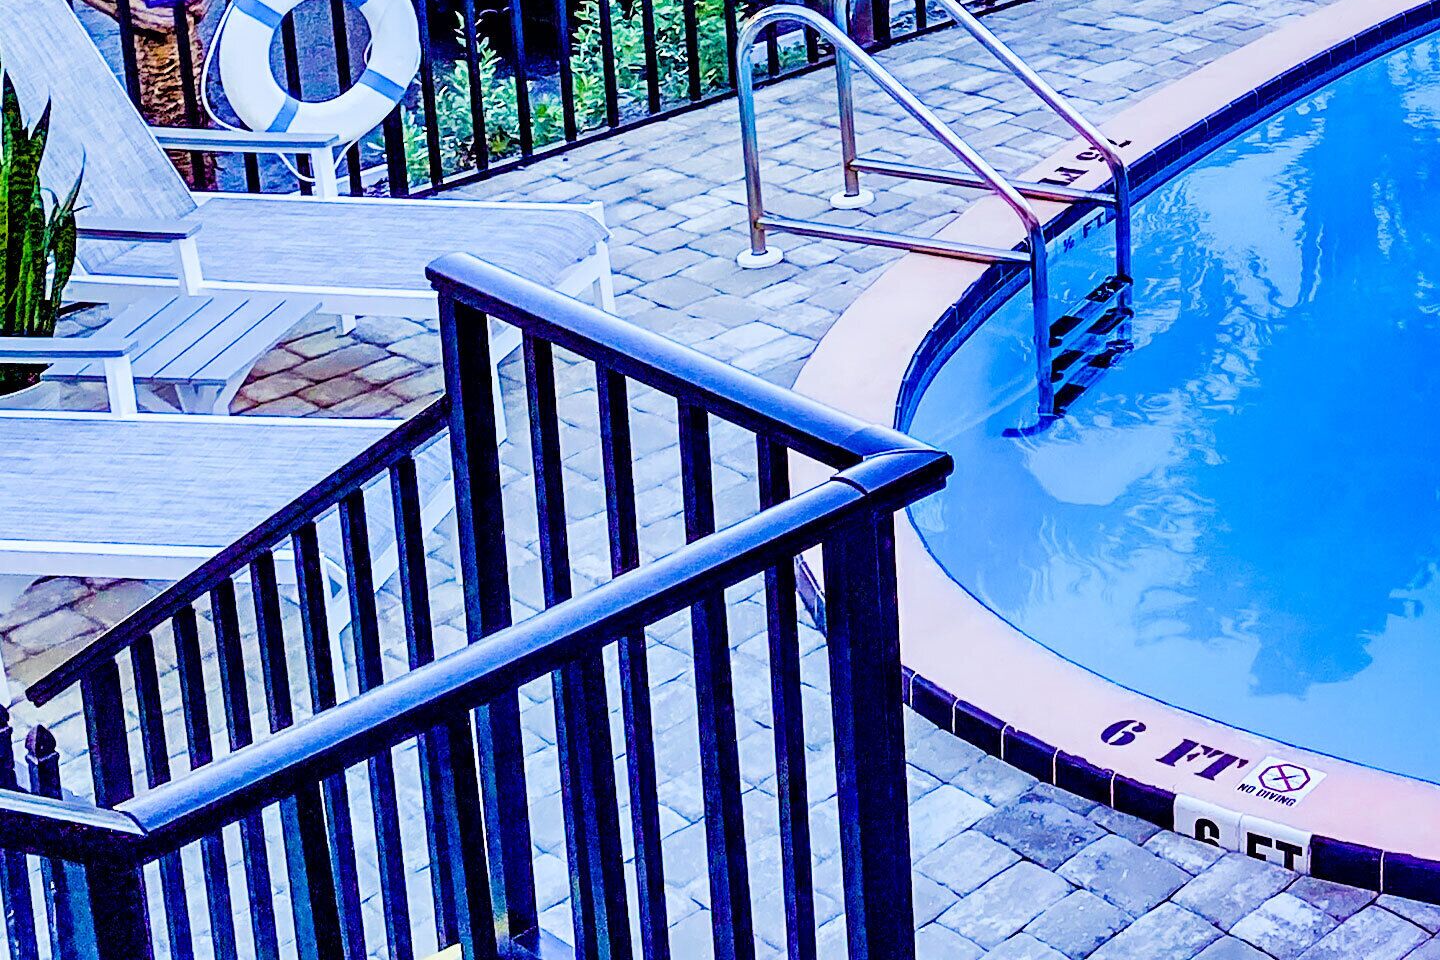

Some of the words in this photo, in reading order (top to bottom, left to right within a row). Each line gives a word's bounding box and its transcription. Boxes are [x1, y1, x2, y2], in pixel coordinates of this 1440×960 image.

[1037, 166, 1089, 187] FT
[1101, 719, 1147, 746] 6
[1156, 738, 1249, 782] FT
[1237, 783, 1256, 794] NO
[1256, 789, 1297, 807] DIVING
[1246, 831, 1303, 871] FT
